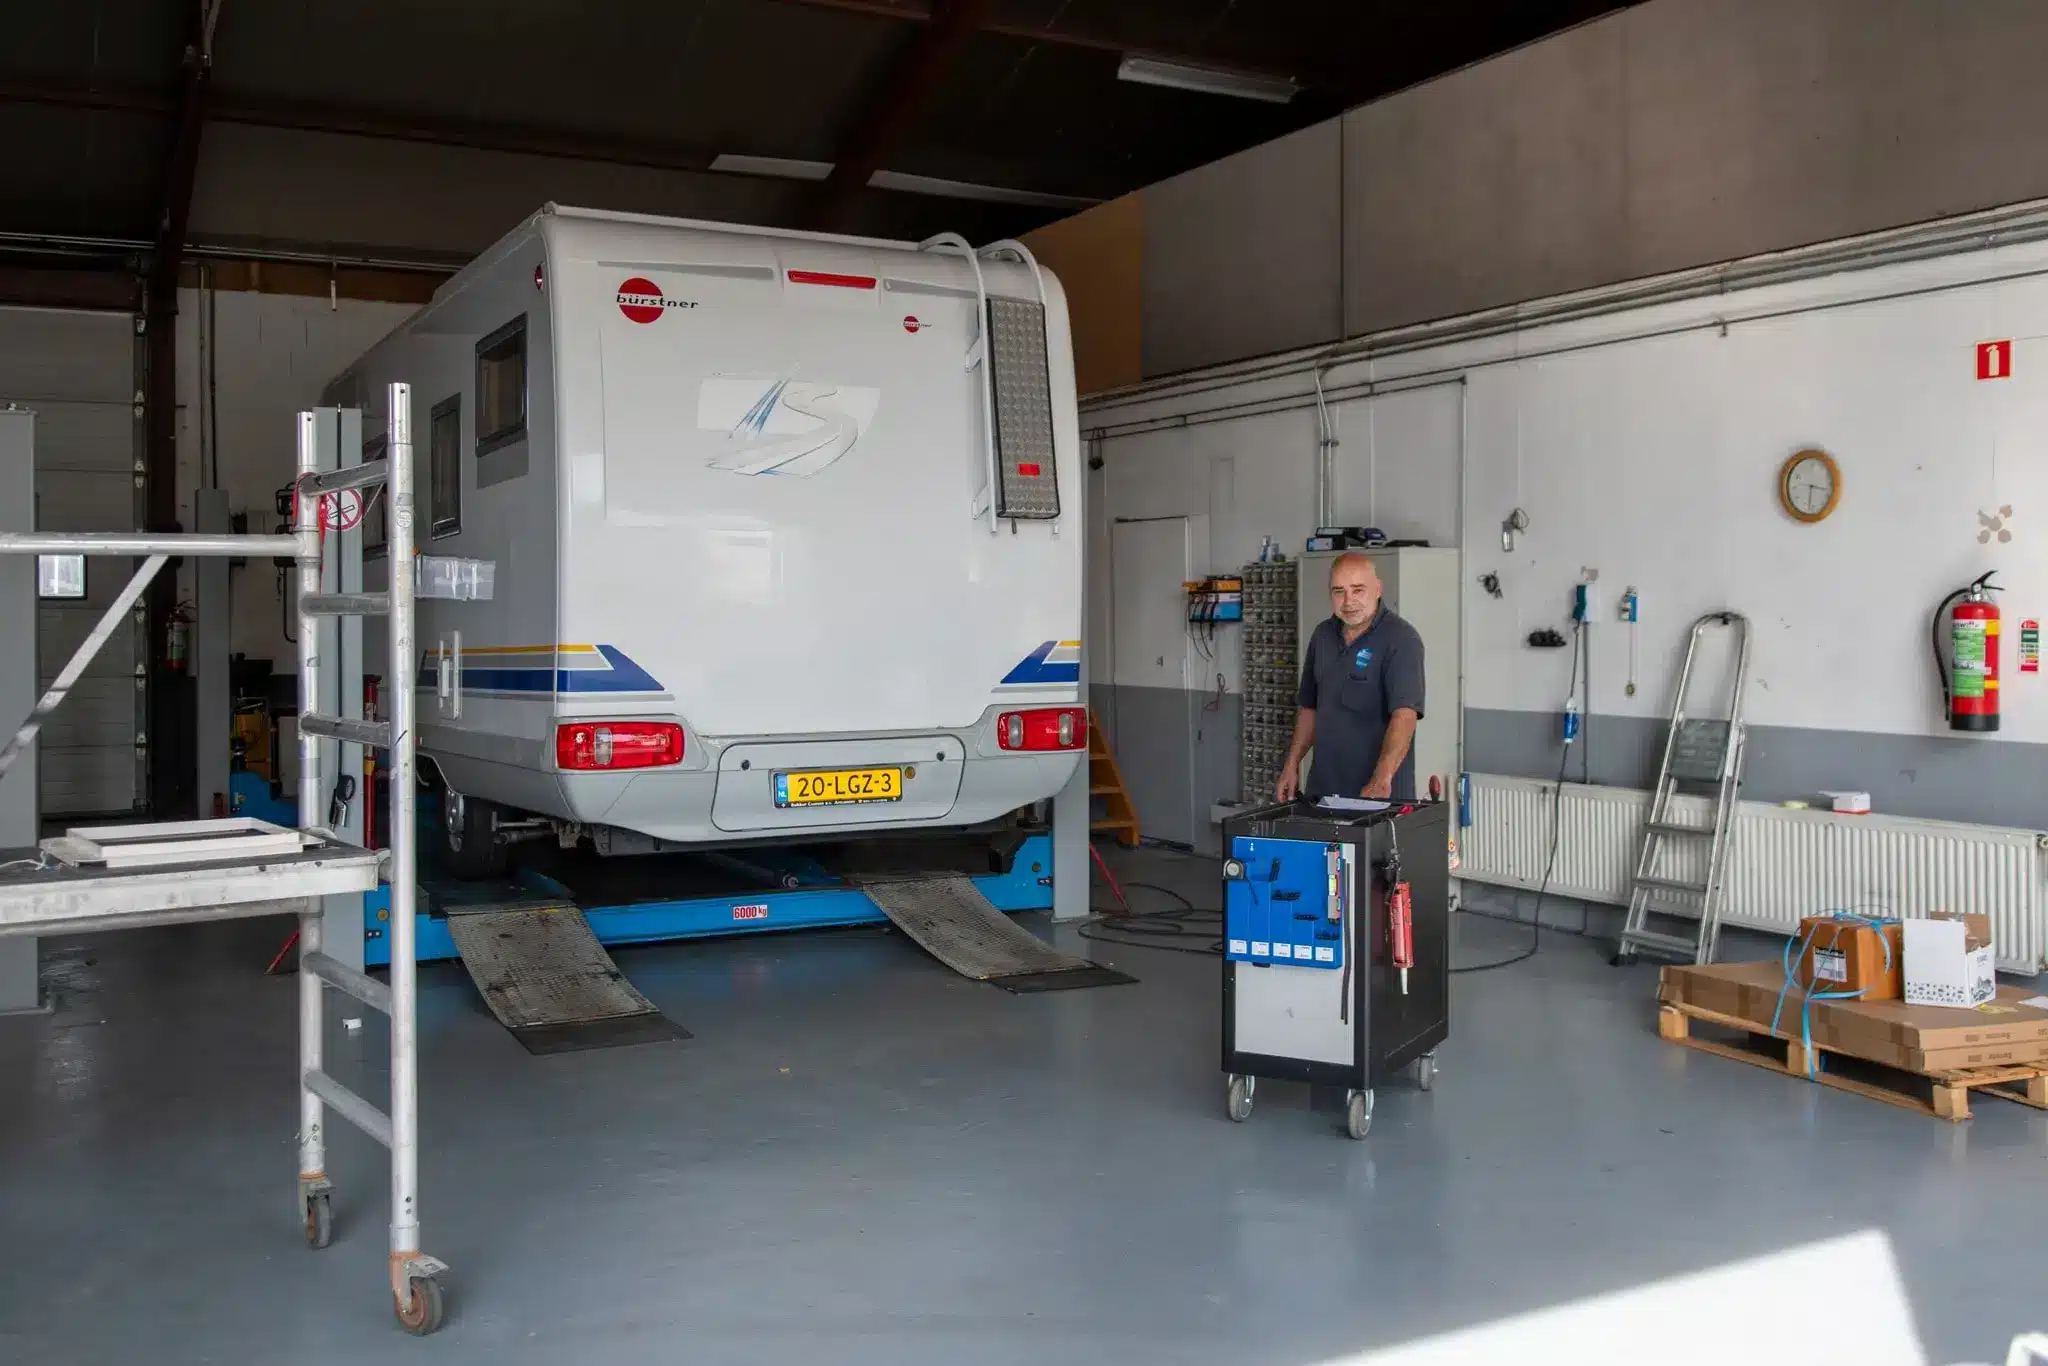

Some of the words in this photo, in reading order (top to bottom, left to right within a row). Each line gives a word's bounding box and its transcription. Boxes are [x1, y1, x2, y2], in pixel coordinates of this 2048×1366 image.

[616, 294, 699, 309] bürstner
[797, 773, 891, 797] 20-LGZ-3
[734, 907, 757, 918] 6000
[759, 906, 767, 917] kg
